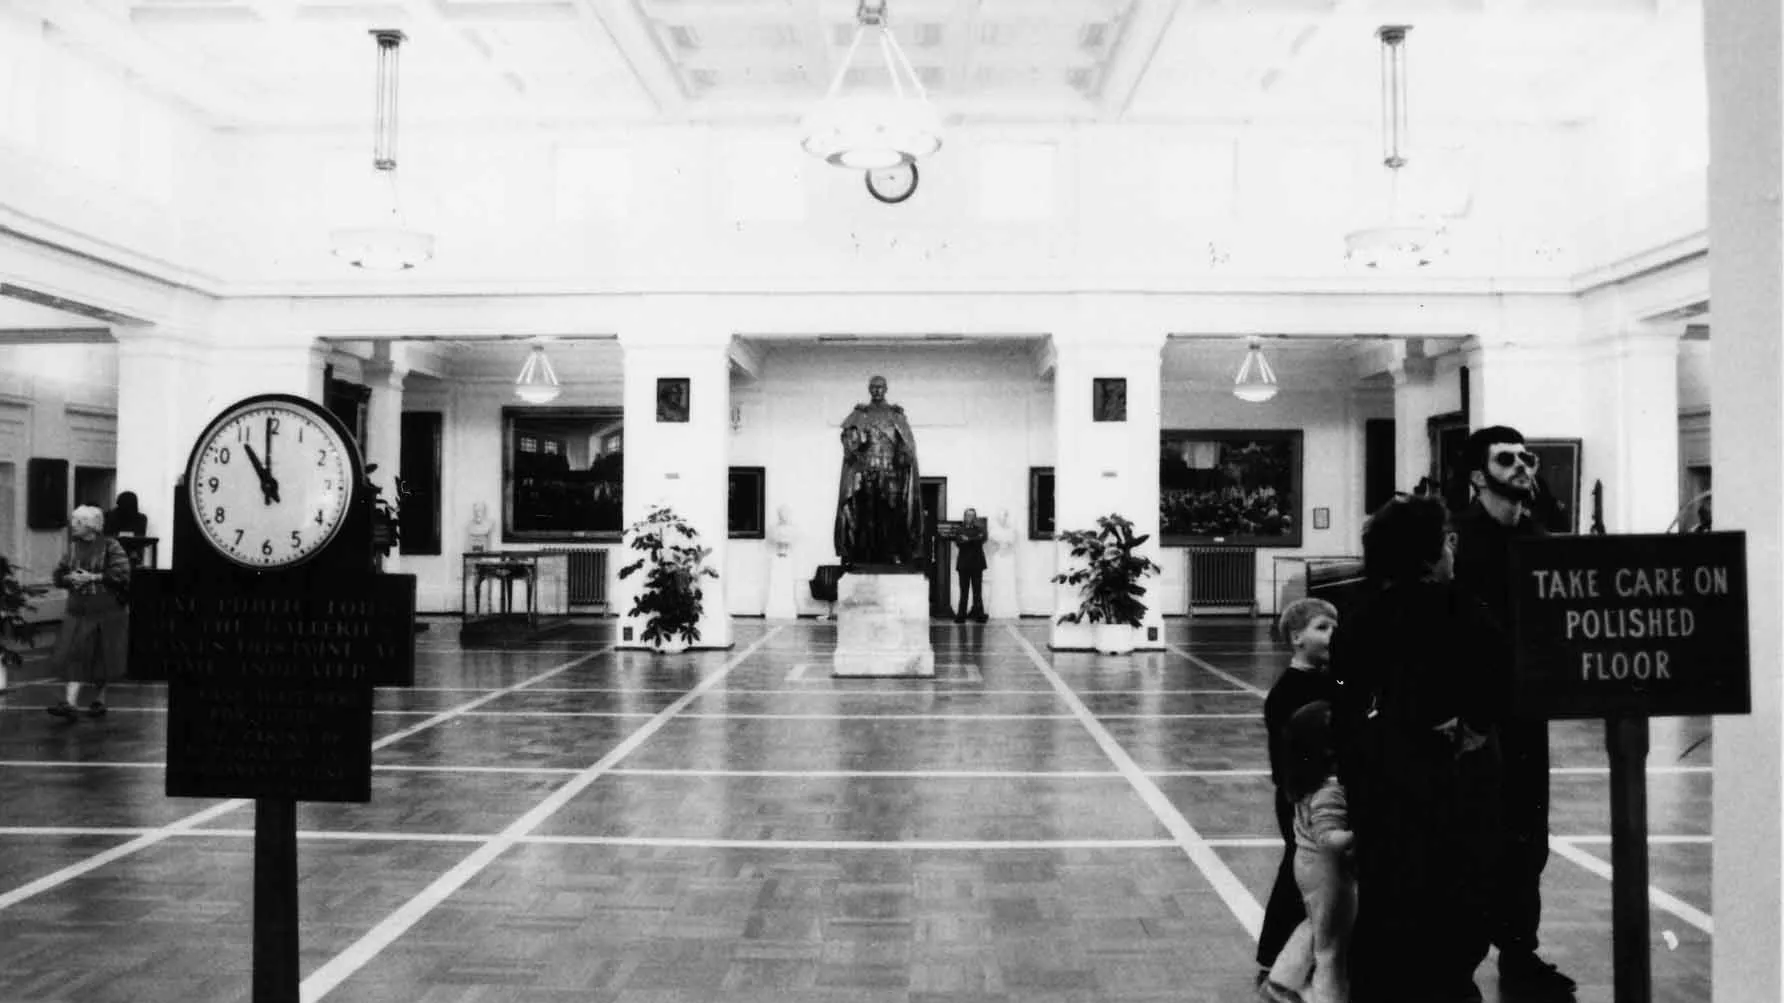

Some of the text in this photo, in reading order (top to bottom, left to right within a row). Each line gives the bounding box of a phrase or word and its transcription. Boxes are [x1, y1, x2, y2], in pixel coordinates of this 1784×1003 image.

[238, 425, 250, 443] 11
[267, 418, 280, 435] 2
[316, 449, 326, 467] 2
[208, 477, 219, 493] 9
[215, 506, 225, 524] 8
[315, 509, 324, 526] 4
[234, 529, 245, 546] 7
[291, 530, 302, 548] 5
[262, 540, 272, 555] 6
[1532, 566, 1729, 599] TAKE CARE ON
[1566, 608, 1695, 639] POLISHED
[1582, 651, 1672, 681] FLOOR
